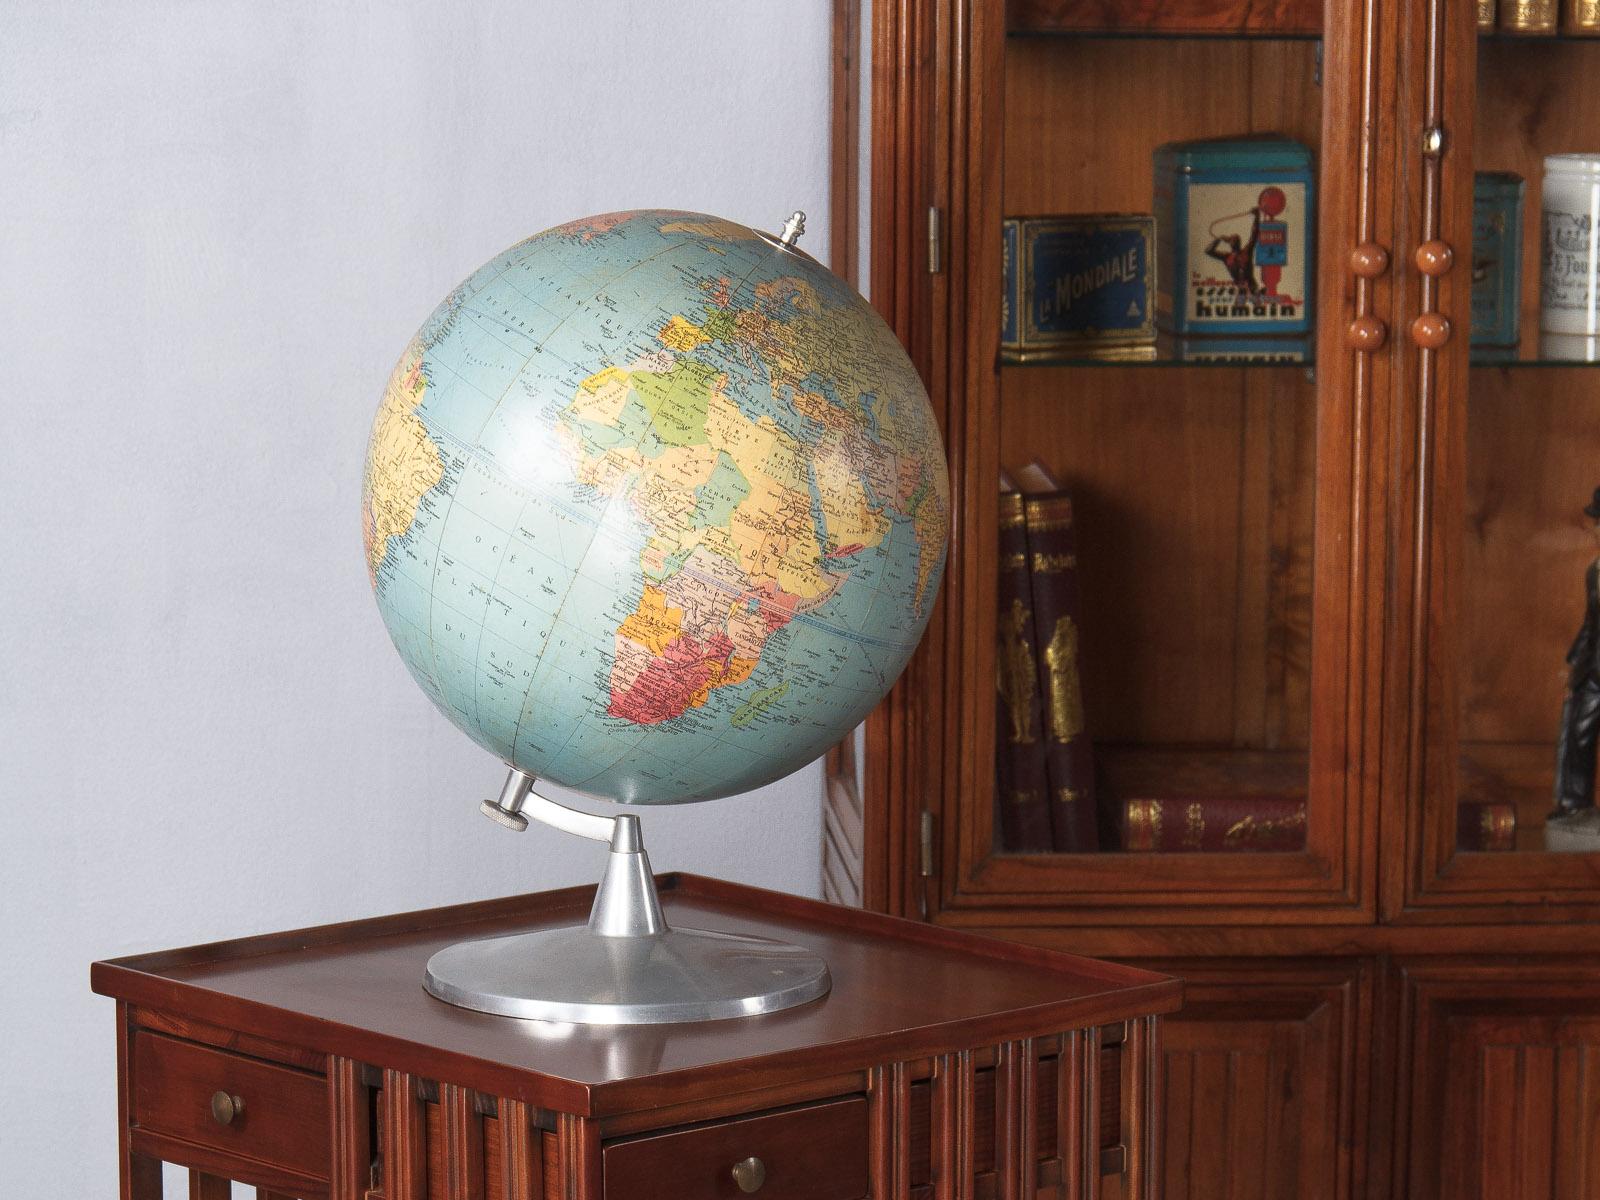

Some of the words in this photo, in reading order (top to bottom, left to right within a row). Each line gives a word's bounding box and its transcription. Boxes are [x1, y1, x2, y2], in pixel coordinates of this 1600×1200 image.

[1055, 248, 1138, 315] MONDIALE
[539, 275, 633, 337] ATLANTIQUE
[1196, 300, 1295, 317] humain
[702, 485, 731, 503] TCHAD
[475, 535, 553, 584] OCÉAN
[689, 579, 720, 598] CONGO
[423, 559, 586, 657] ATLANTIQUE
[643, 612, 677, 634] ANGOLA
[490, 651, 530, 678] SUD
[737, 687, 783, 721] MADAGASCAR
